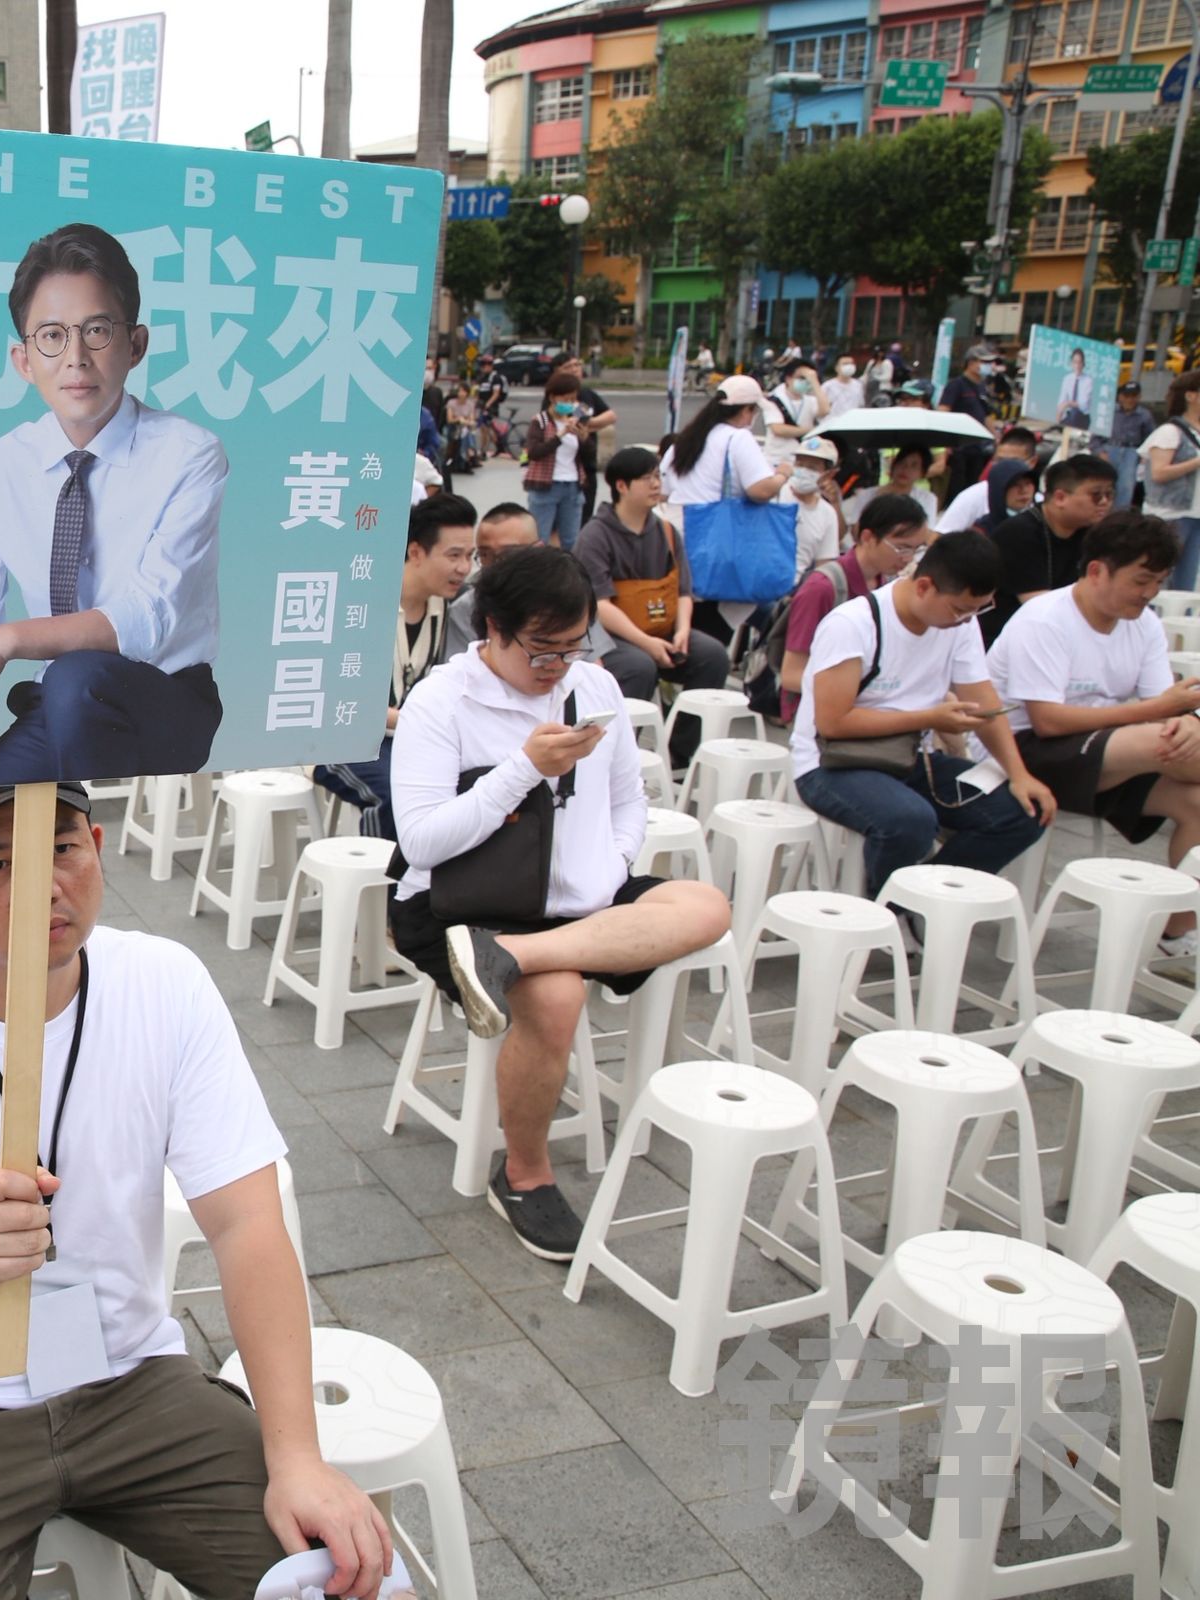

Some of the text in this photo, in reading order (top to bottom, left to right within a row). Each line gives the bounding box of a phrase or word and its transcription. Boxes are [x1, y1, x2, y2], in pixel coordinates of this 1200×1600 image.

[183, 167, 414, 224] BEST
[266, 451, 350, 731] 黃國昌
[334, 453, 383, 726] 為你做到最好
